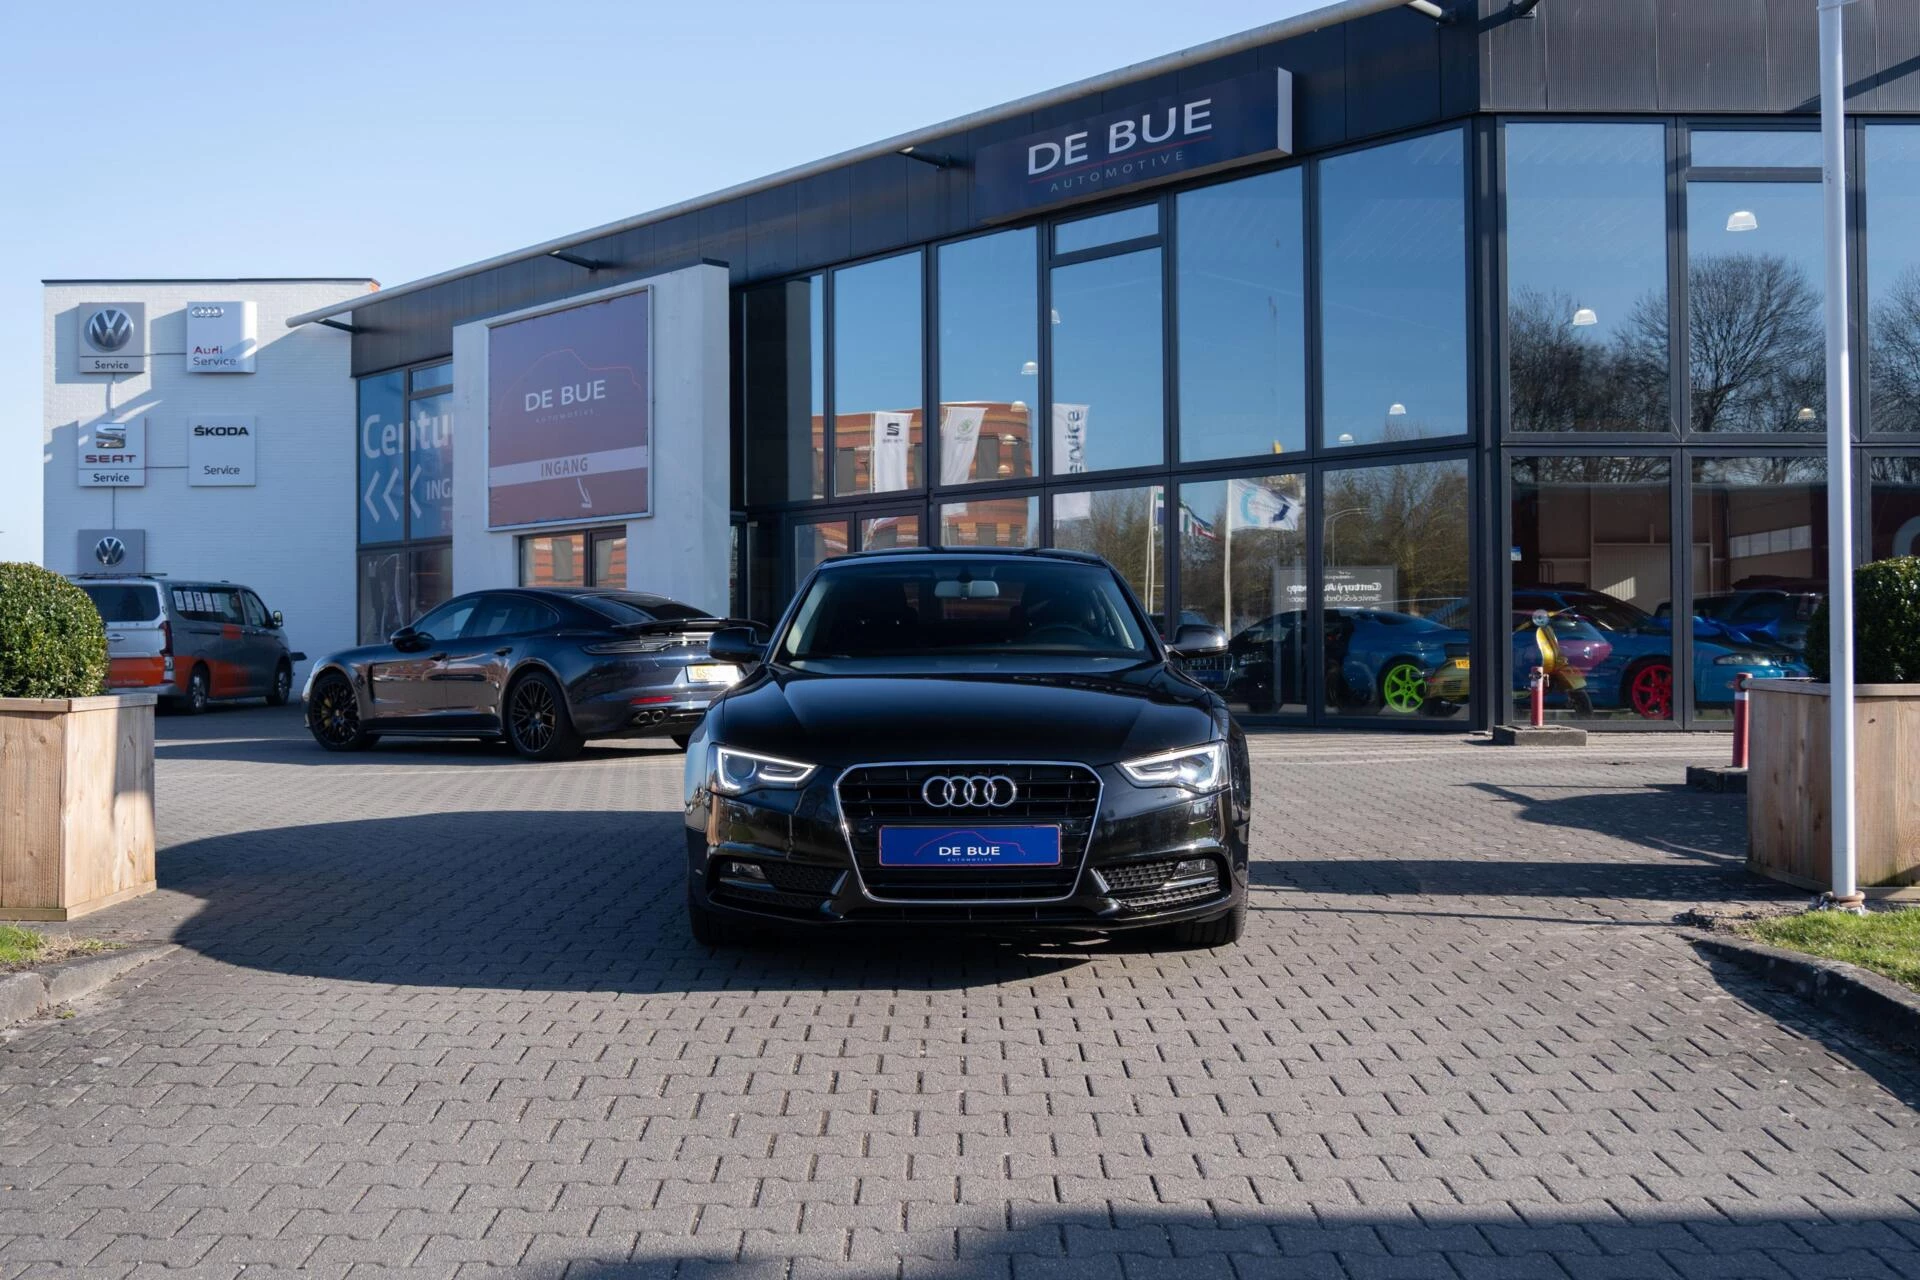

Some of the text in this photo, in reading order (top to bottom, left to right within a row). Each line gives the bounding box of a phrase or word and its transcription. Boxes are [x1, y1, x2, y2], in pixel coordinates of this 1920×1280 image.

[1028, 98, 1212, 175] DE BUE
[1050, 151, 1184, 192] AUTOMOTIVE
[193, 346, 223, 355] Audi
[94, 361, 129, 369] Service
[193, 357, 237, 366] Service
[525, 380, 606, 412] DE BUE
[363, 411, 454, 458] Centu
[1065, 411, 1083, 473] ervice
[85, 454, 137, 463] SEAT
[204, 465, 240, 475] Service
[541, 457, 588, 477] INGANG
[93, 473, 130, 482] Service
[426, 478, 453, 500] ING
[939, 846, 1001, 856] DE BUE
